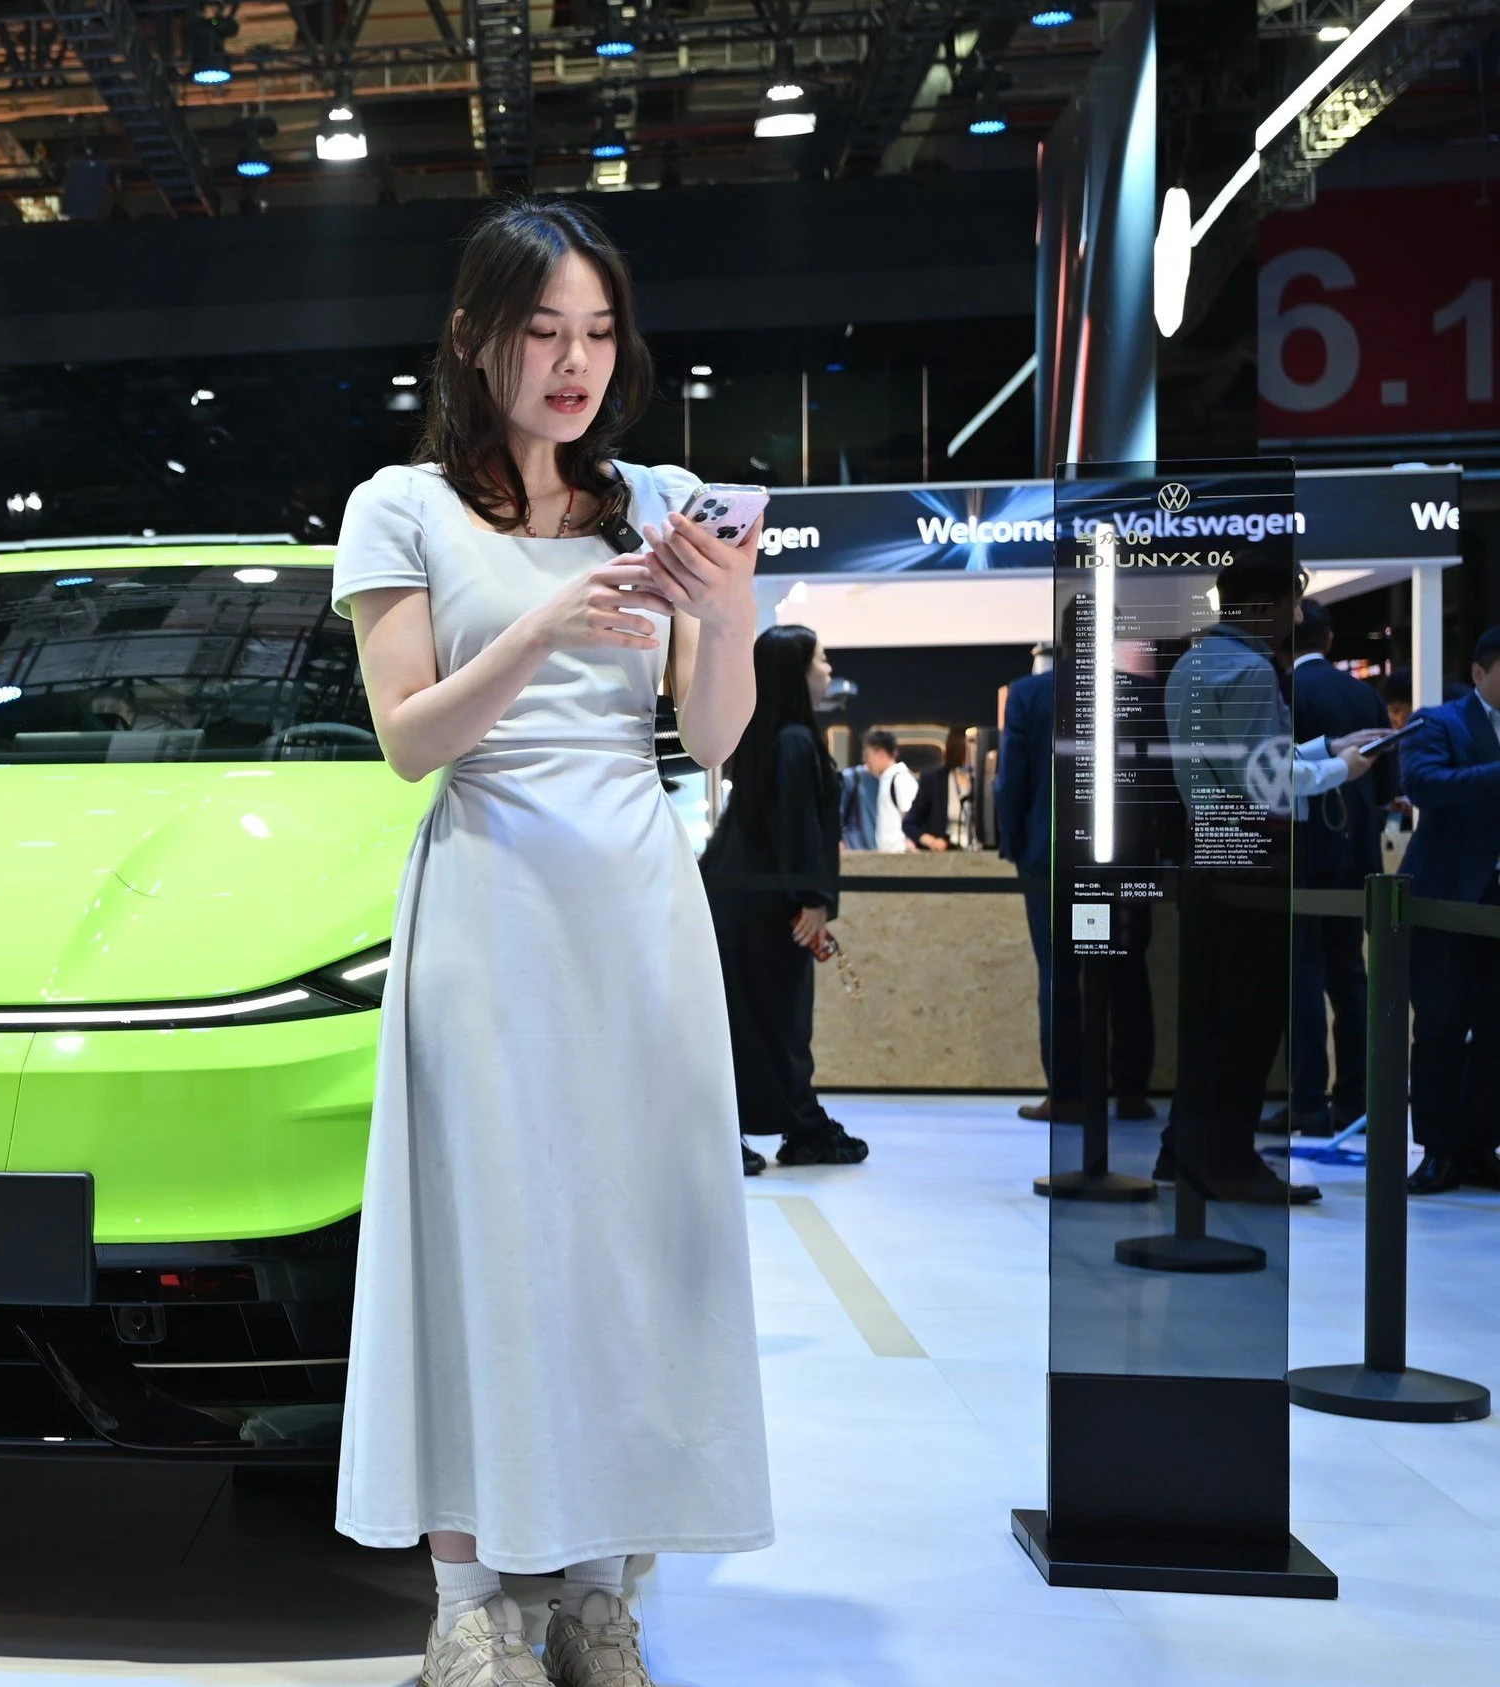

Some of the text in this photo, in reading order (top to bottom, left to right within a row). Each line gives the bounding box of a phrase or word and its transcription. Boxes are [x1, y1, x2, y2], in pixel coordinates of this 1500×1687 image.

[916, 515, 1061, 546] Welcome
[1113, 509, 1306, 542] Volkswagen
[1125, 531, 1152, 546] 06
[1207, 551, 1234, 567] 06
